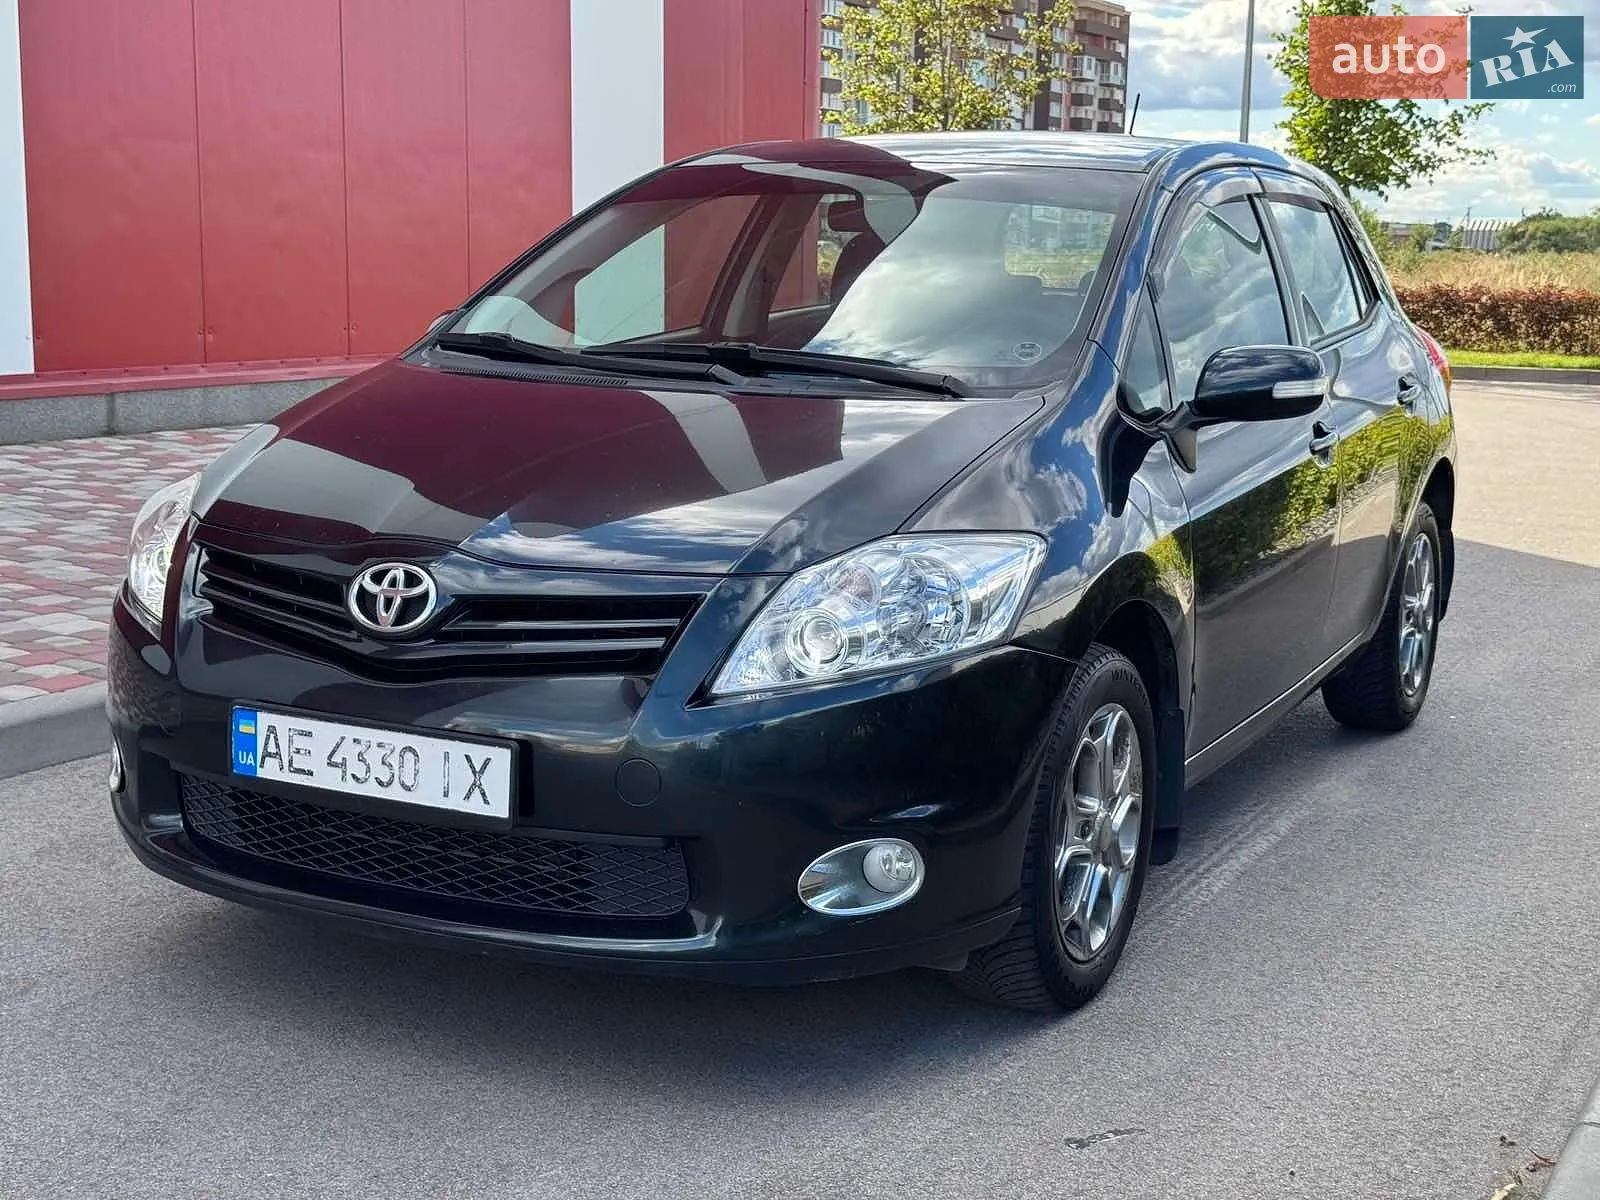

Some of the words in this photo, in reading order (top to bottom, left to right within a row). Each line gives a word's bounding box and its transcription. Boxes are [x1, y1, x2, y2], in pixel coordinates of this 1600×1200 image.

[238, 752, 255, 767] UA
[259, 725, 314, 777] AE
[326, 736, 420, 792] 4330
